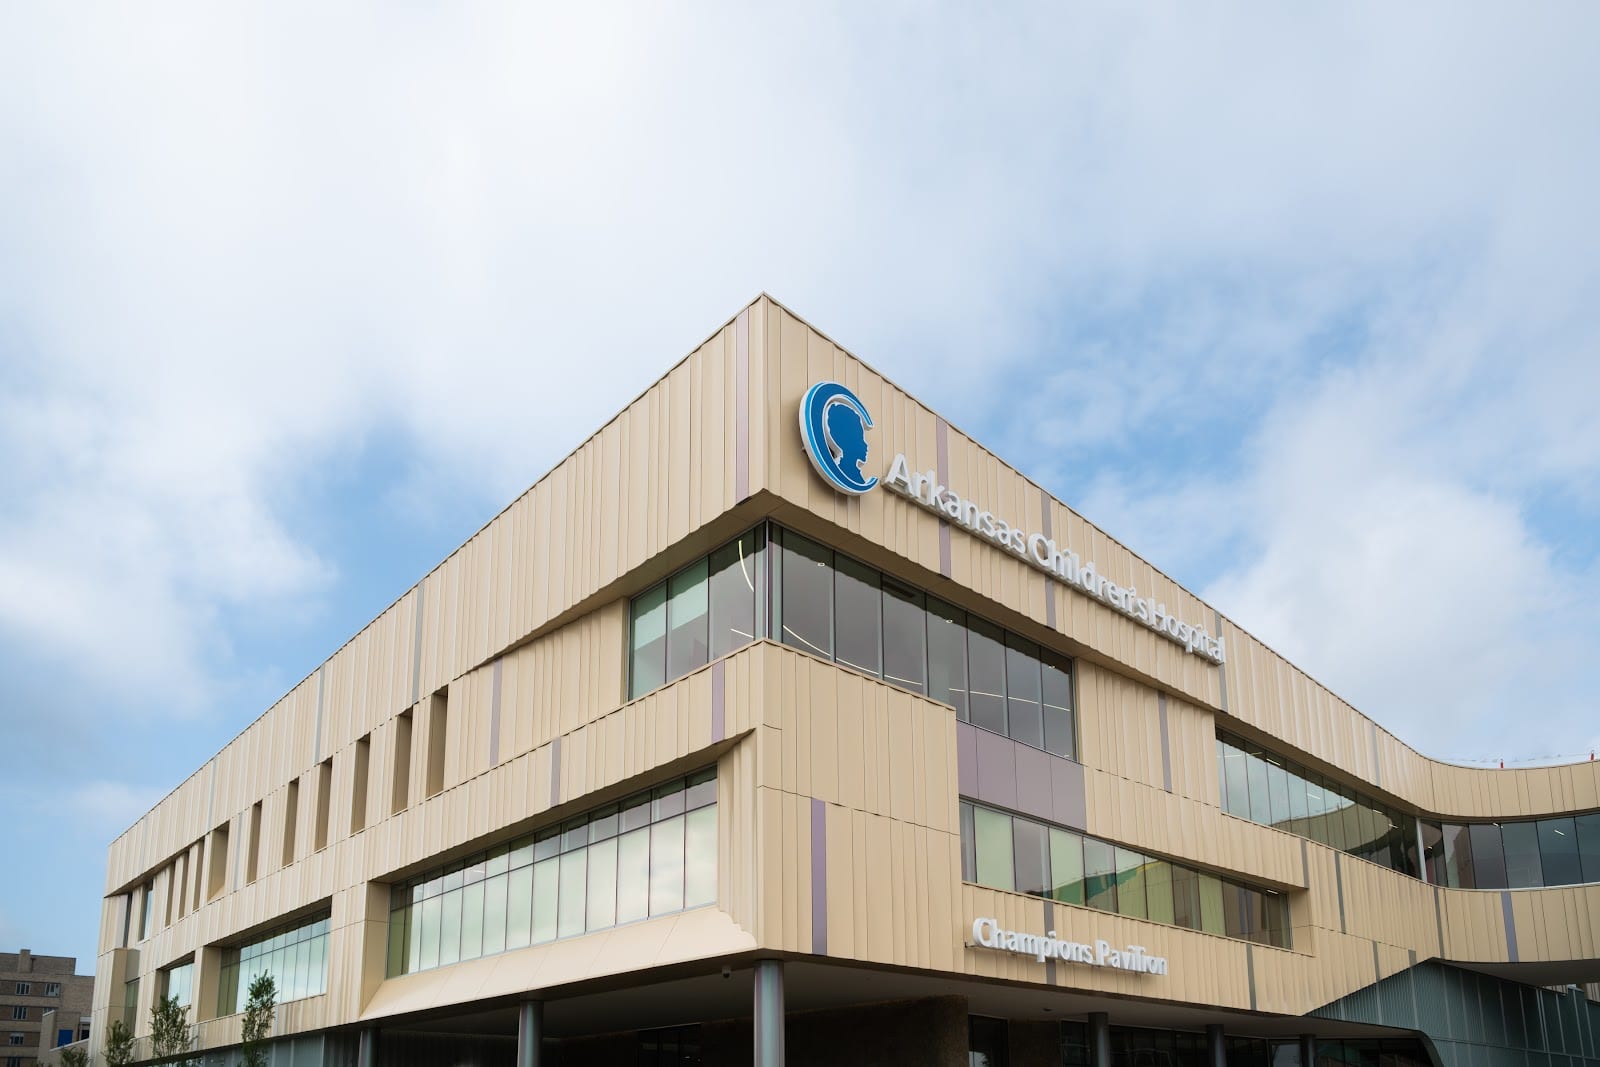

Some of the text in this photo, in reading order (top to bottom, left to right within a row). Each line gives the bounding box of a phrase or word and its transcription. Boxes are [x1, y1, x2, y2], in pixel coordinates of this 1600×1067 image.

[885, 453, 1226, 664] Arkansas Children's Hospital
[972, 917, 1168, 975] Champions Pavilion
